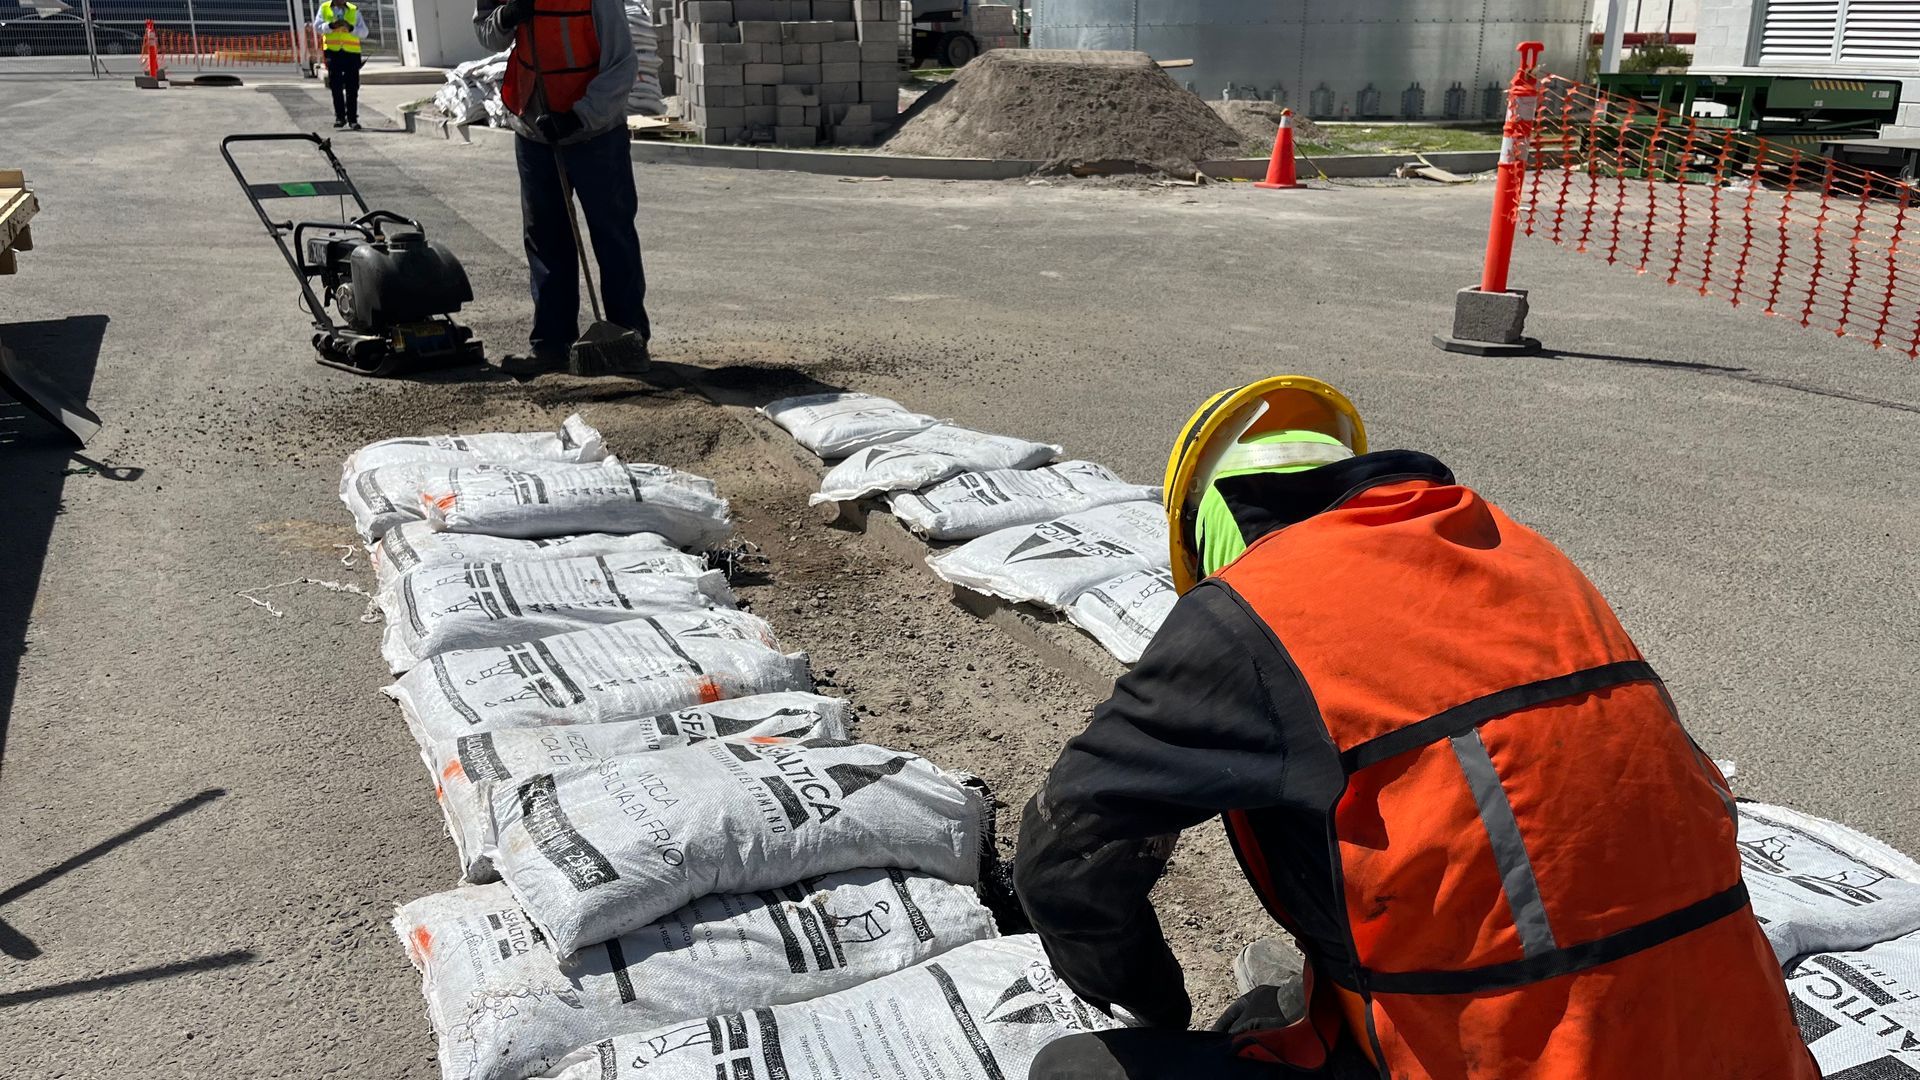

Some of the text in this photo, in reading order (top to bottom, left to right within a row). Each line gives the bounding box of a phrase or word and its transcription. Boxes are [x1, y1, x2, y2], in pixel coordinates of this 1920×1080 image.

[752, 743, 841, 824] ÁLTICA
[623, 801, 653, 821] EN
[748, 786, 787, 834] CAMINO
[565, 850, 605, 884] 25KG
[1790, 966, 1920, 1053] ÁLTICA
